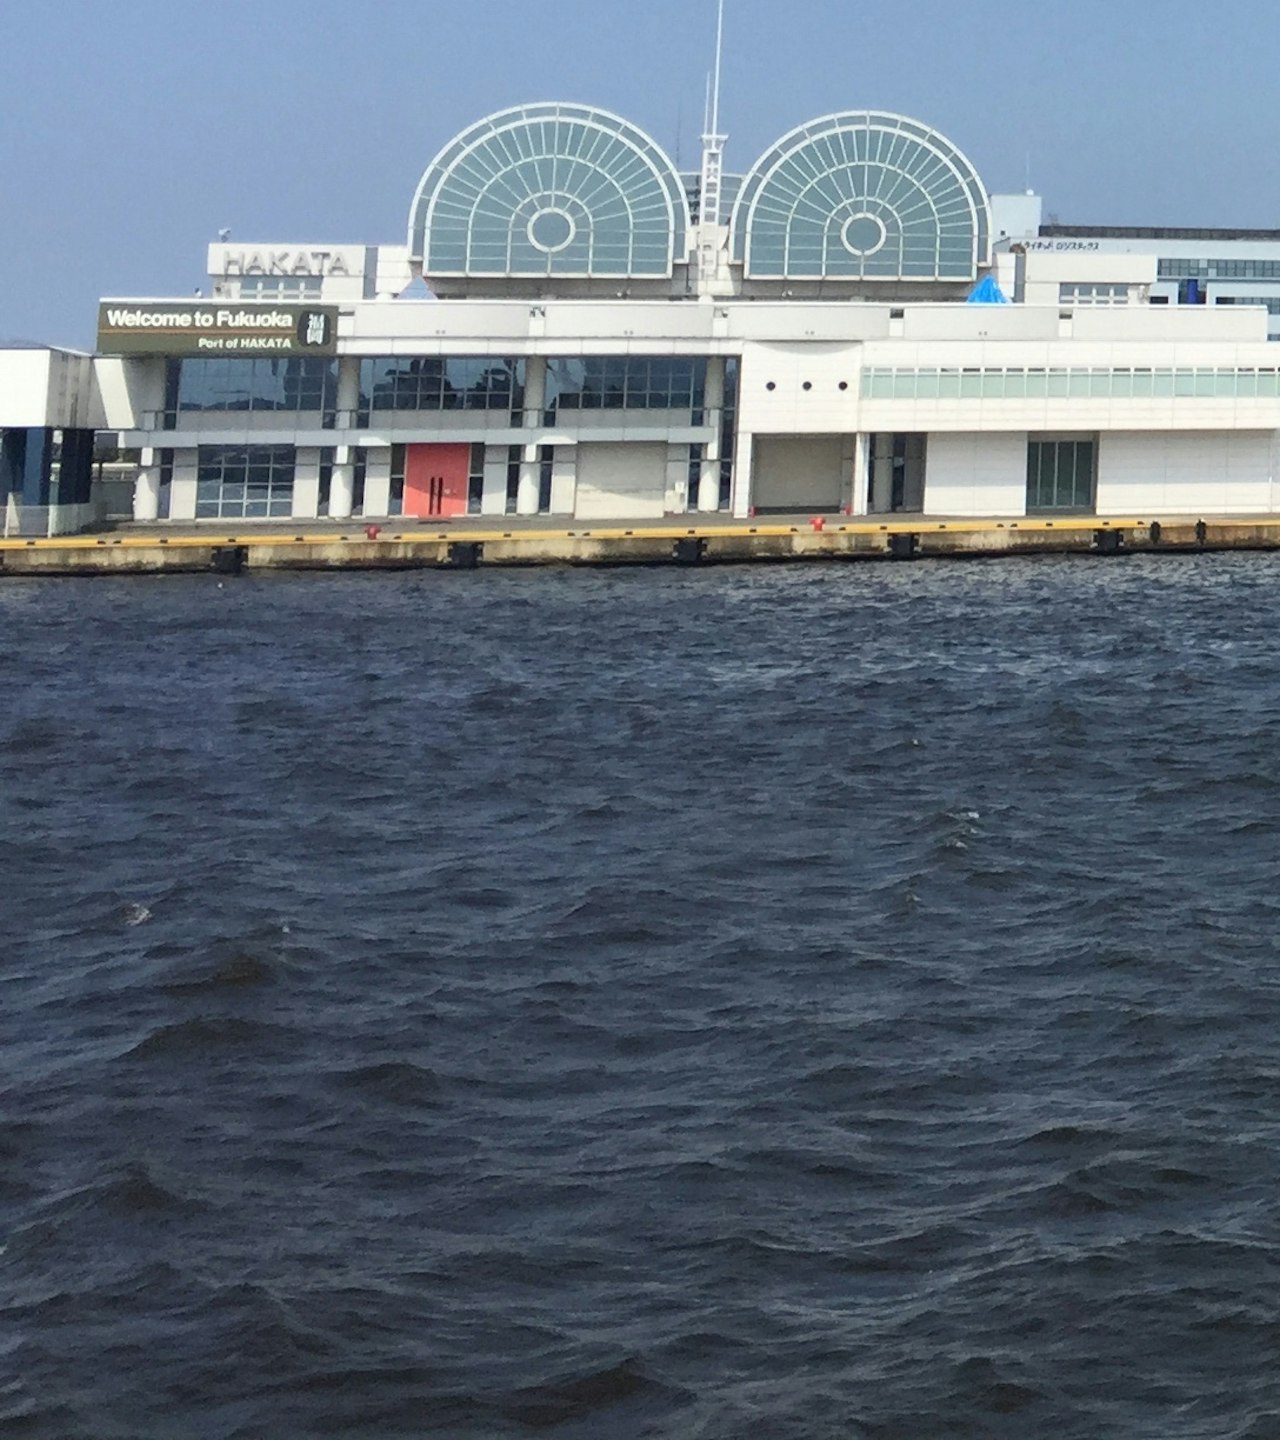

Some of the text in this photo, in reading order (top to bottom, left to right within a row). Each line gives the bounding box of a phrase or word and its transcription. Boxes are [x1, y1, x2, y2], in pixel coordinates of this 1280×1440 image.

[223, 250, 350, 276] HAKATA
[107, 309, 293, 327] Welcome to Fukuoka
[198, 337, 292, 349] Port of HAKATA
